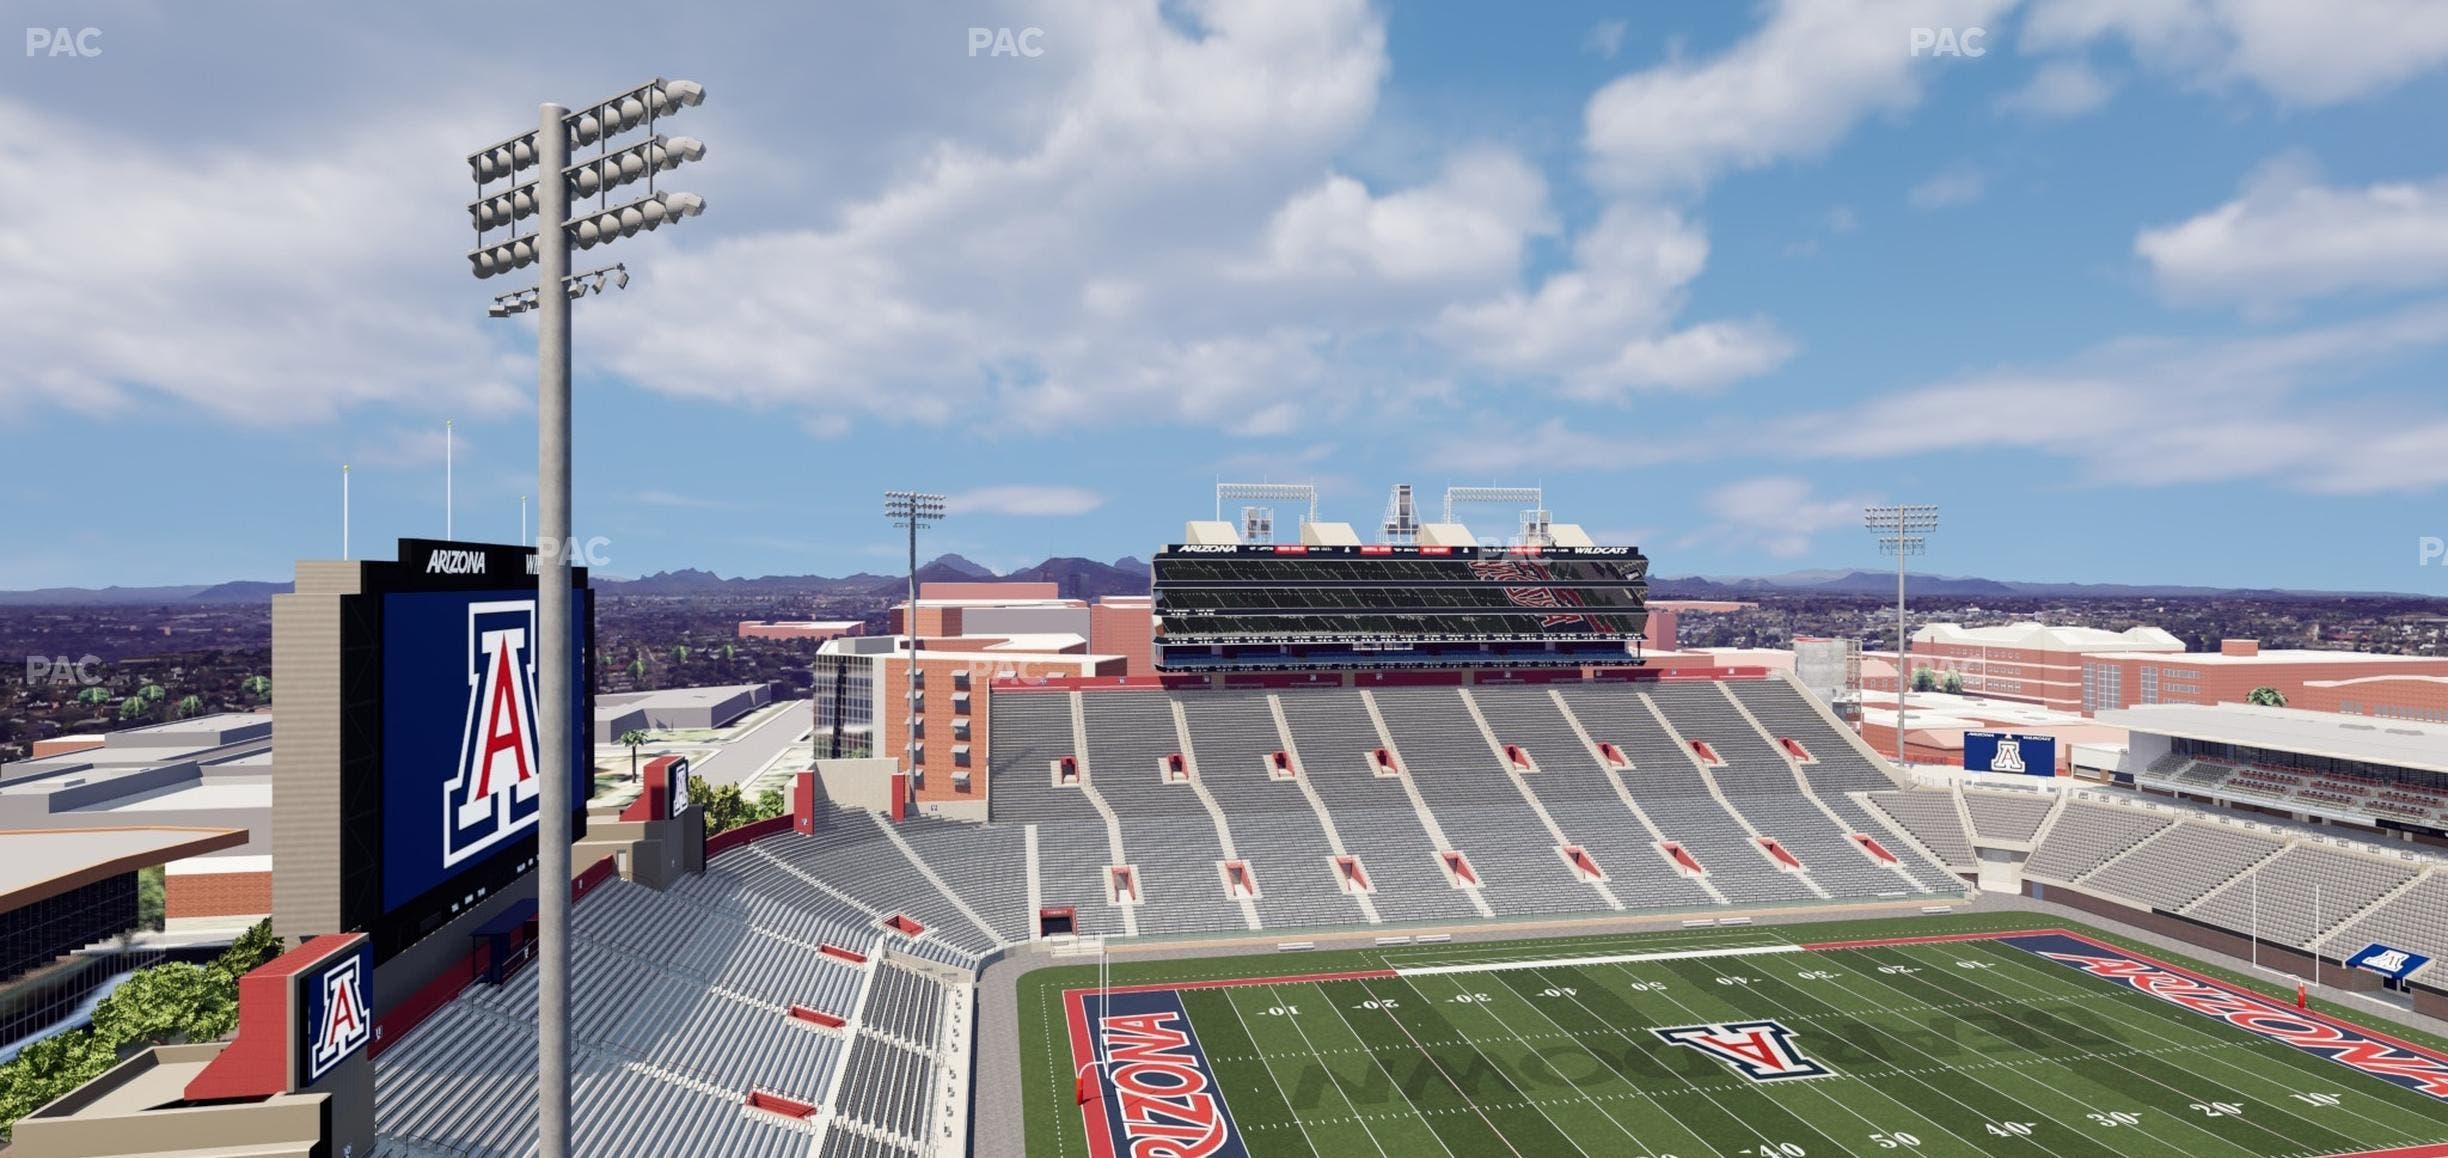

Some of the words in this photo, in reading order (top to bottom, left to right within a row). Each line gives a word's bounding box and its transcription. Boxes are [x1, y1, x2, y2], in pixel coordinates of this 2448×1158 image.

[1178, 545, 1237, 553] ARIZONA
[1574, 546, 1628, 554] WILDCATS
[426, 549, 486, 574] ARIZONA
[1991, 740, 2025, 773] A
[1879, 964, 1912, 975] 20
[1956, 960, 1988, 969] 10
[1715, 974, 1749, 985] 40
[1799, 969, 1834, 980] 30
[1545, 985, 1578, 998] 40
[1632, 981, 1667, 992] 50
[1455, 992, 1491, 1003] 30
[1267, 1005, 1302, 1016] 10
[1362, 1000, 1399, 1010] 20
[312, 954, 370, 1079] A
[2289, 1093, 2340, 1107] 10
[2189, 1102, 2242, 1117] 20
[2086, 1111, 2138, 1127] 30
[1985, 1121, 2032, 1137] 40
[1869, 1132, 1920, 1151] 50
